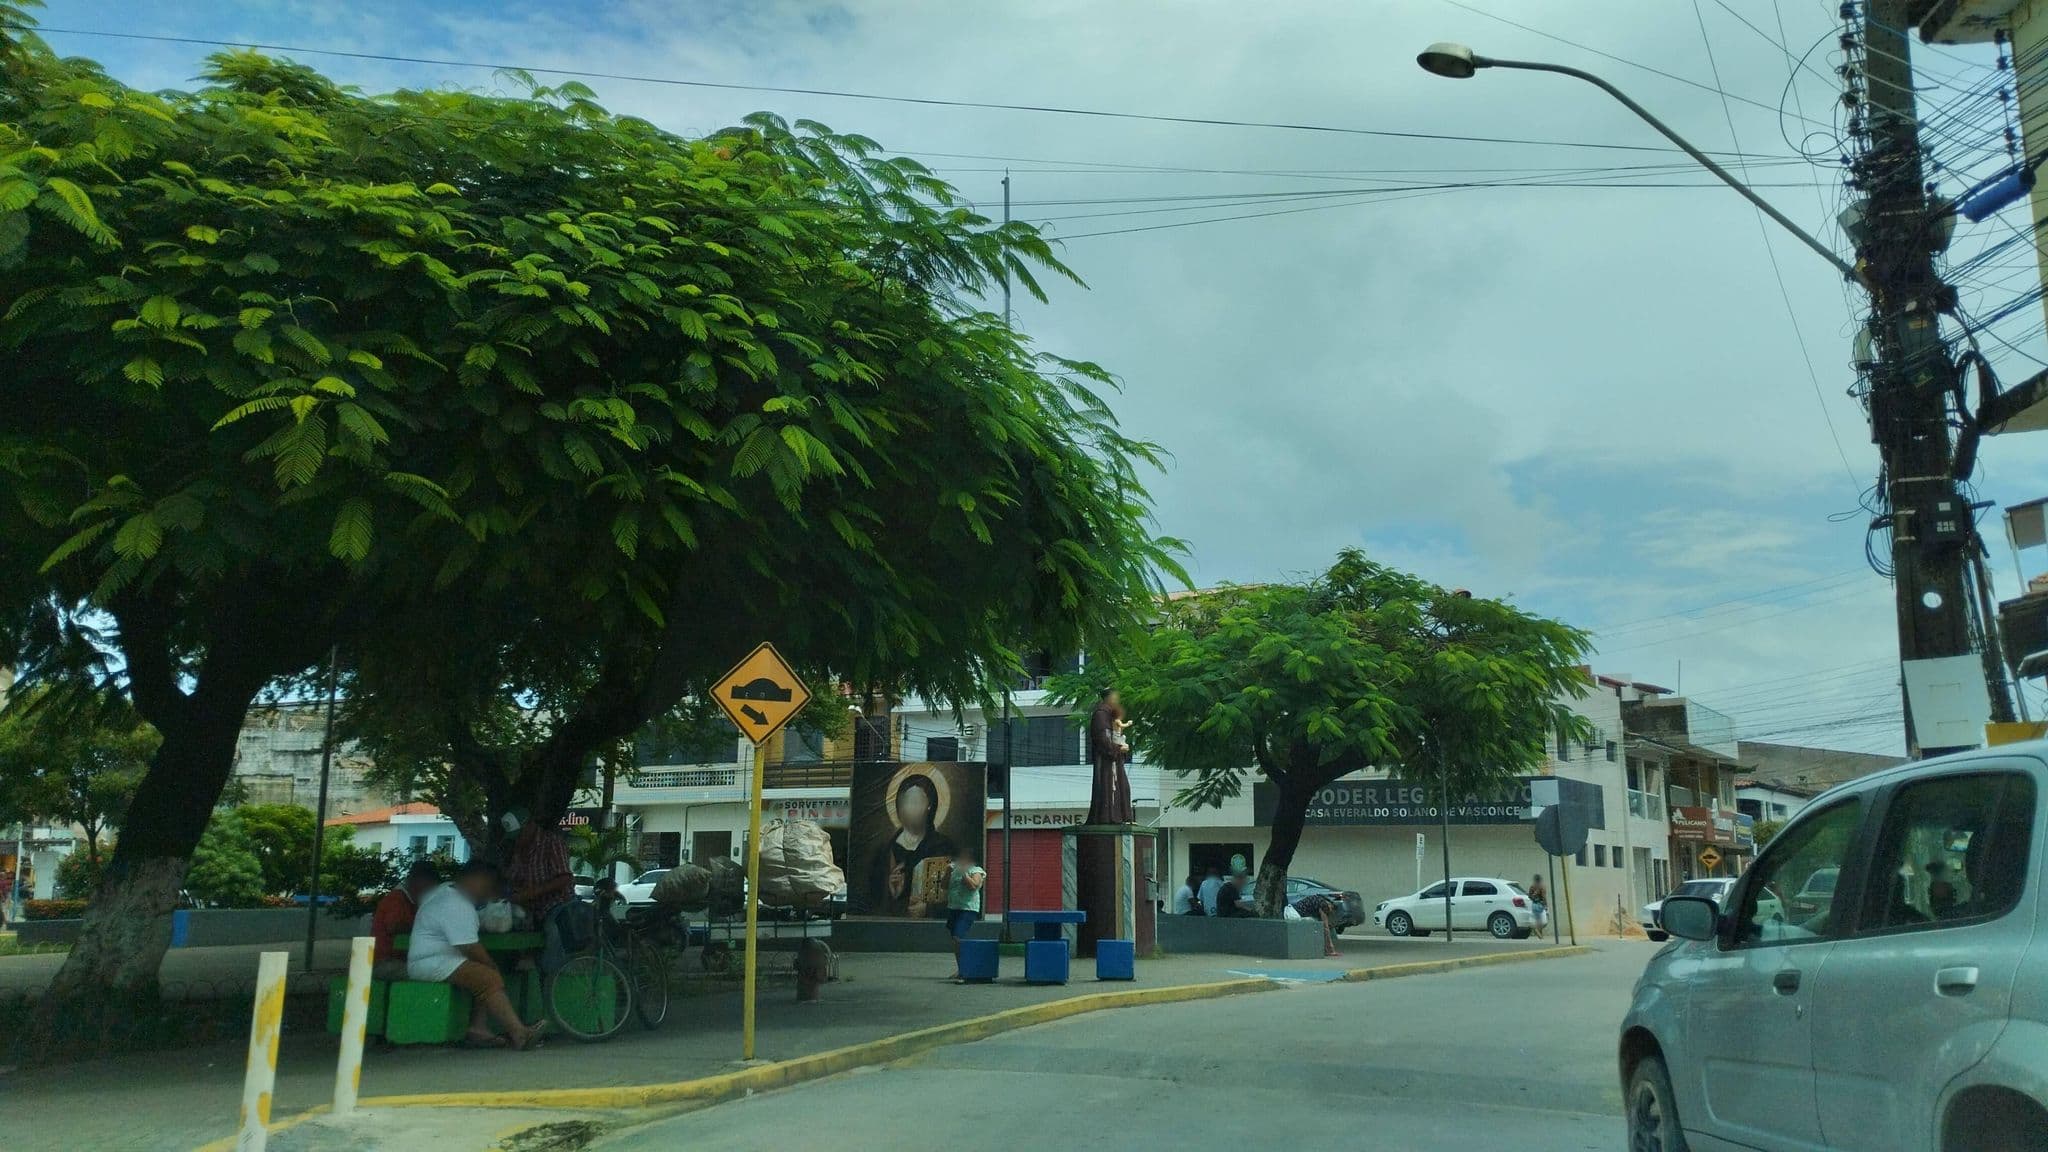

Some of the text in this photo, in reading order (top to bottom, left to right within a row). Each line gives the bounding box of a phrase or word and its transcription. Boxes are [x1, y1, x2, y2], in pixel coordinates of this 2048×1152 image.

[784, 800, 849, 809] SORVETERIA
[1304, 808, 1331, 818] CASA
[1333, 807, 1389, 818] EVERALDO
[1392, 806, 1437, 818] SOLANO
